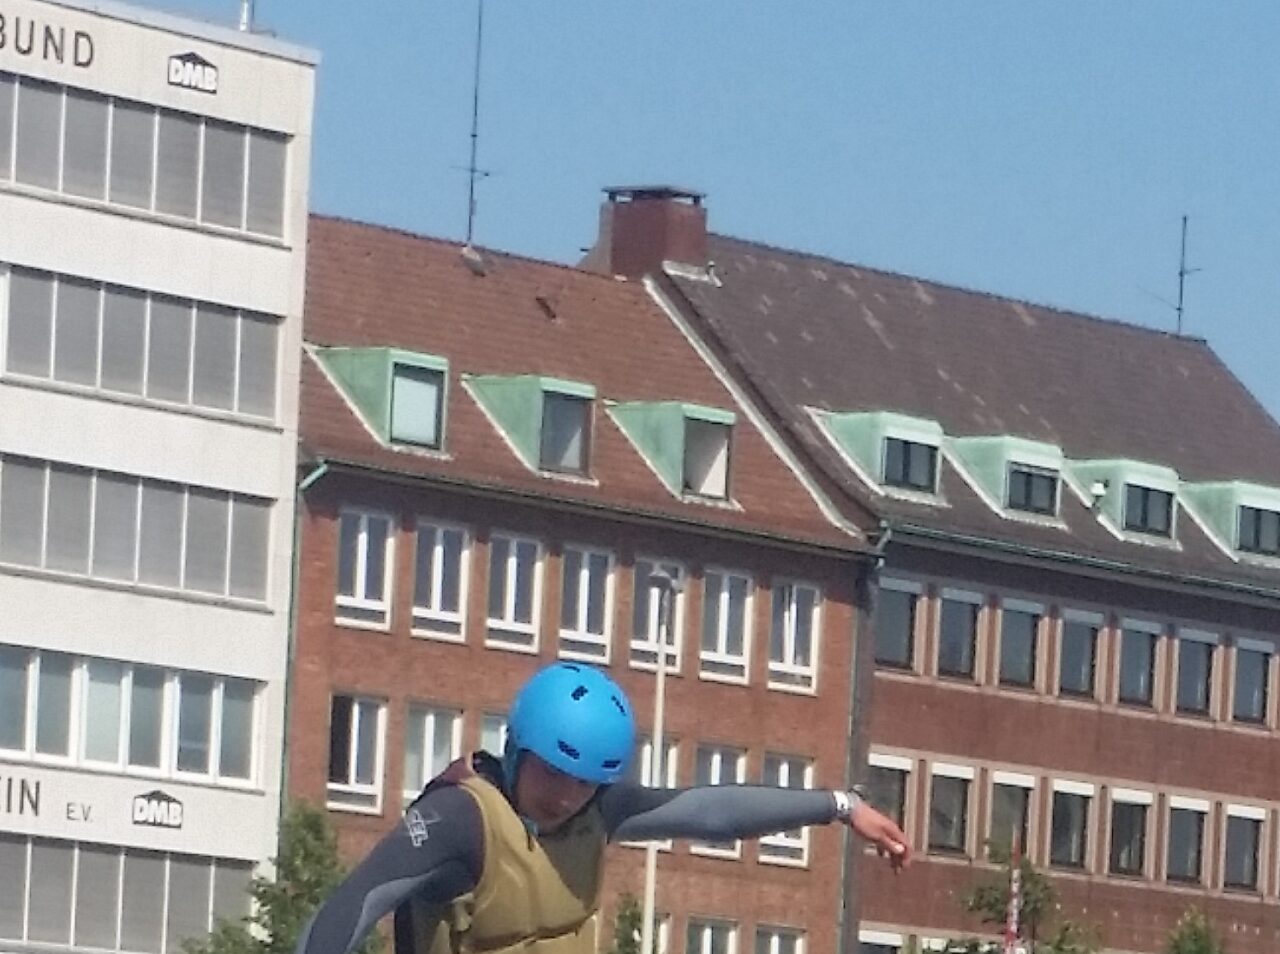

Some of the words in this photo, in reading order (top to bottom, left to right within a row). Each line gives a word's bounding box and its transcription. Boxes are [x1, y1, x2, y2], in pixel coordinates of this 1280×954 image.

[0, 13, 94, 68] UND
[168, 55, 218, 92] DMB
[0, 776, 40, 817] IN
[133, 796, 183, 828] DMB
